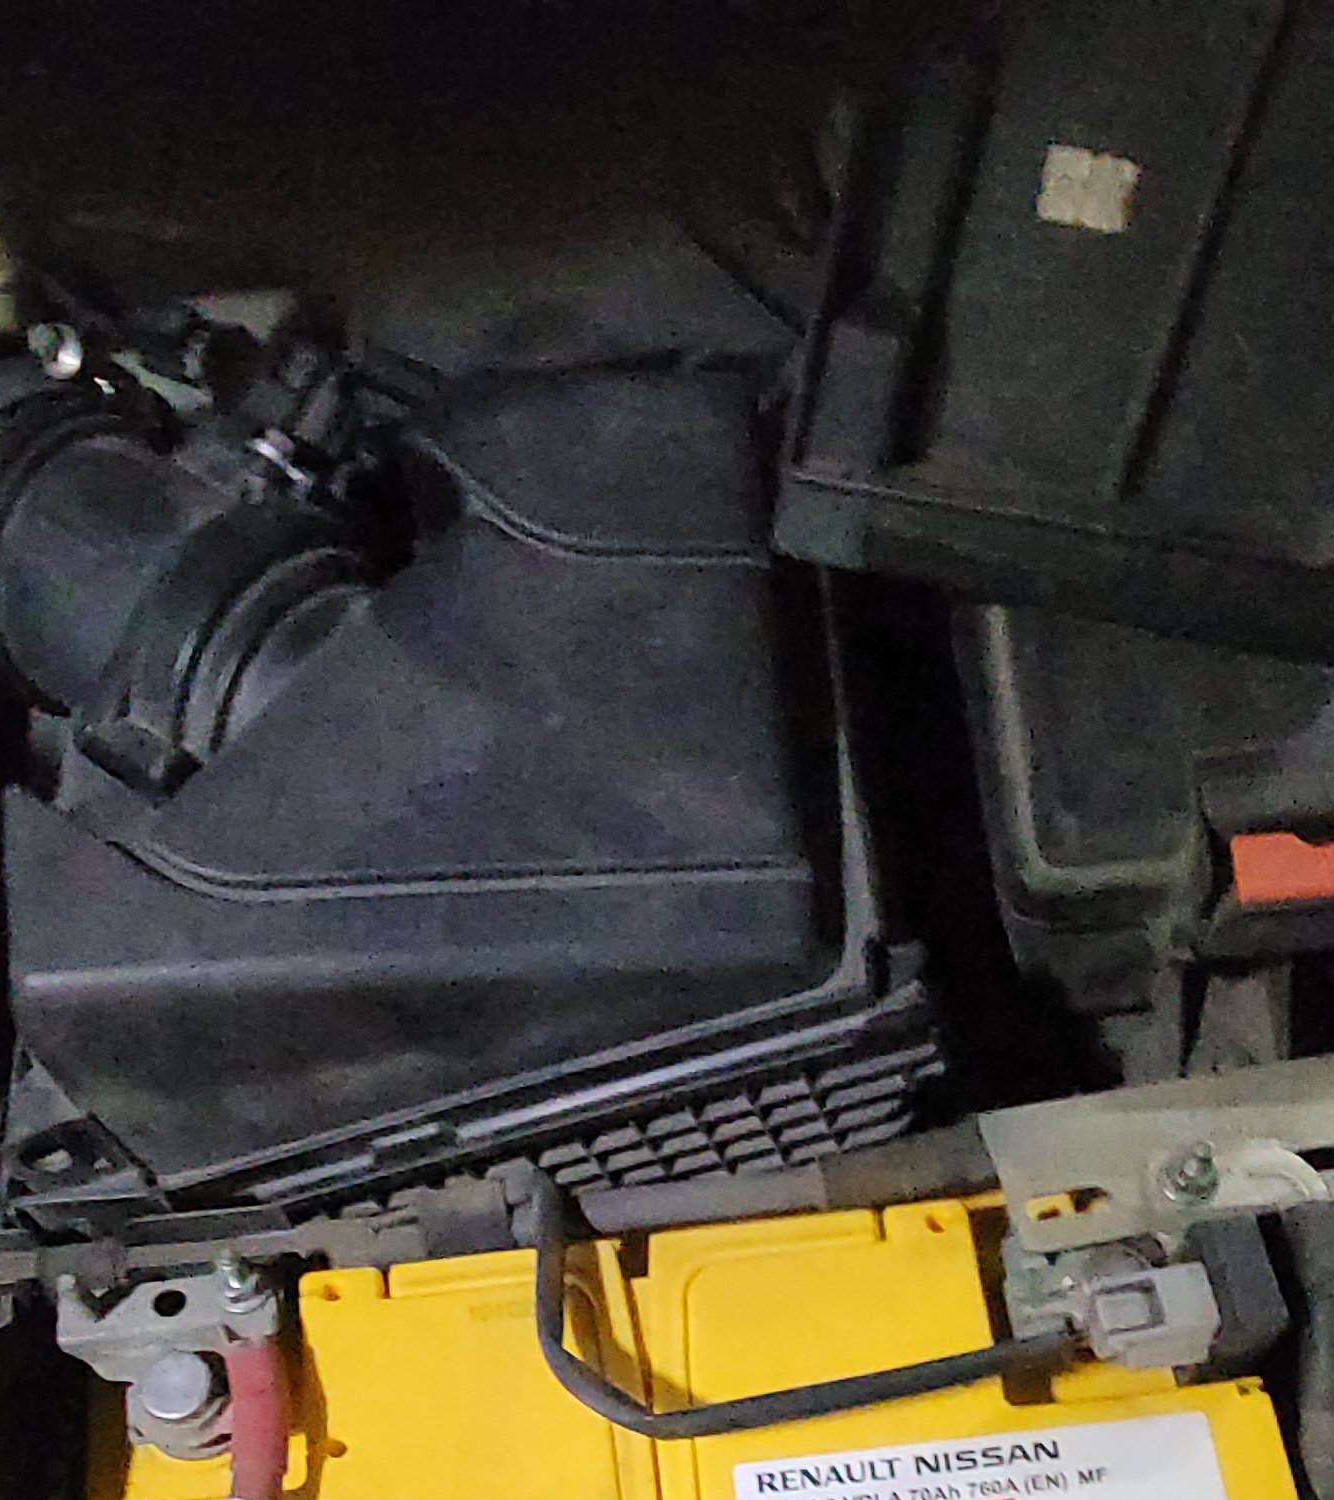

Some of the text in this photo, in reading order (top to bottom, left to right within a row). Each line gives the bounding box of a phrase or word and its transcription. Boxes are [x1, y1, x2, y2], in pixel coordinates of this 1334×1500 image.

[756, 1440, 1060, 1494] RENAULT NISSAN
[967, 1477, 1020, 1498] 760A
[1024, 1471, 1069, 1496] (EN)
[1077, 1466, 1108, 1486] MF
